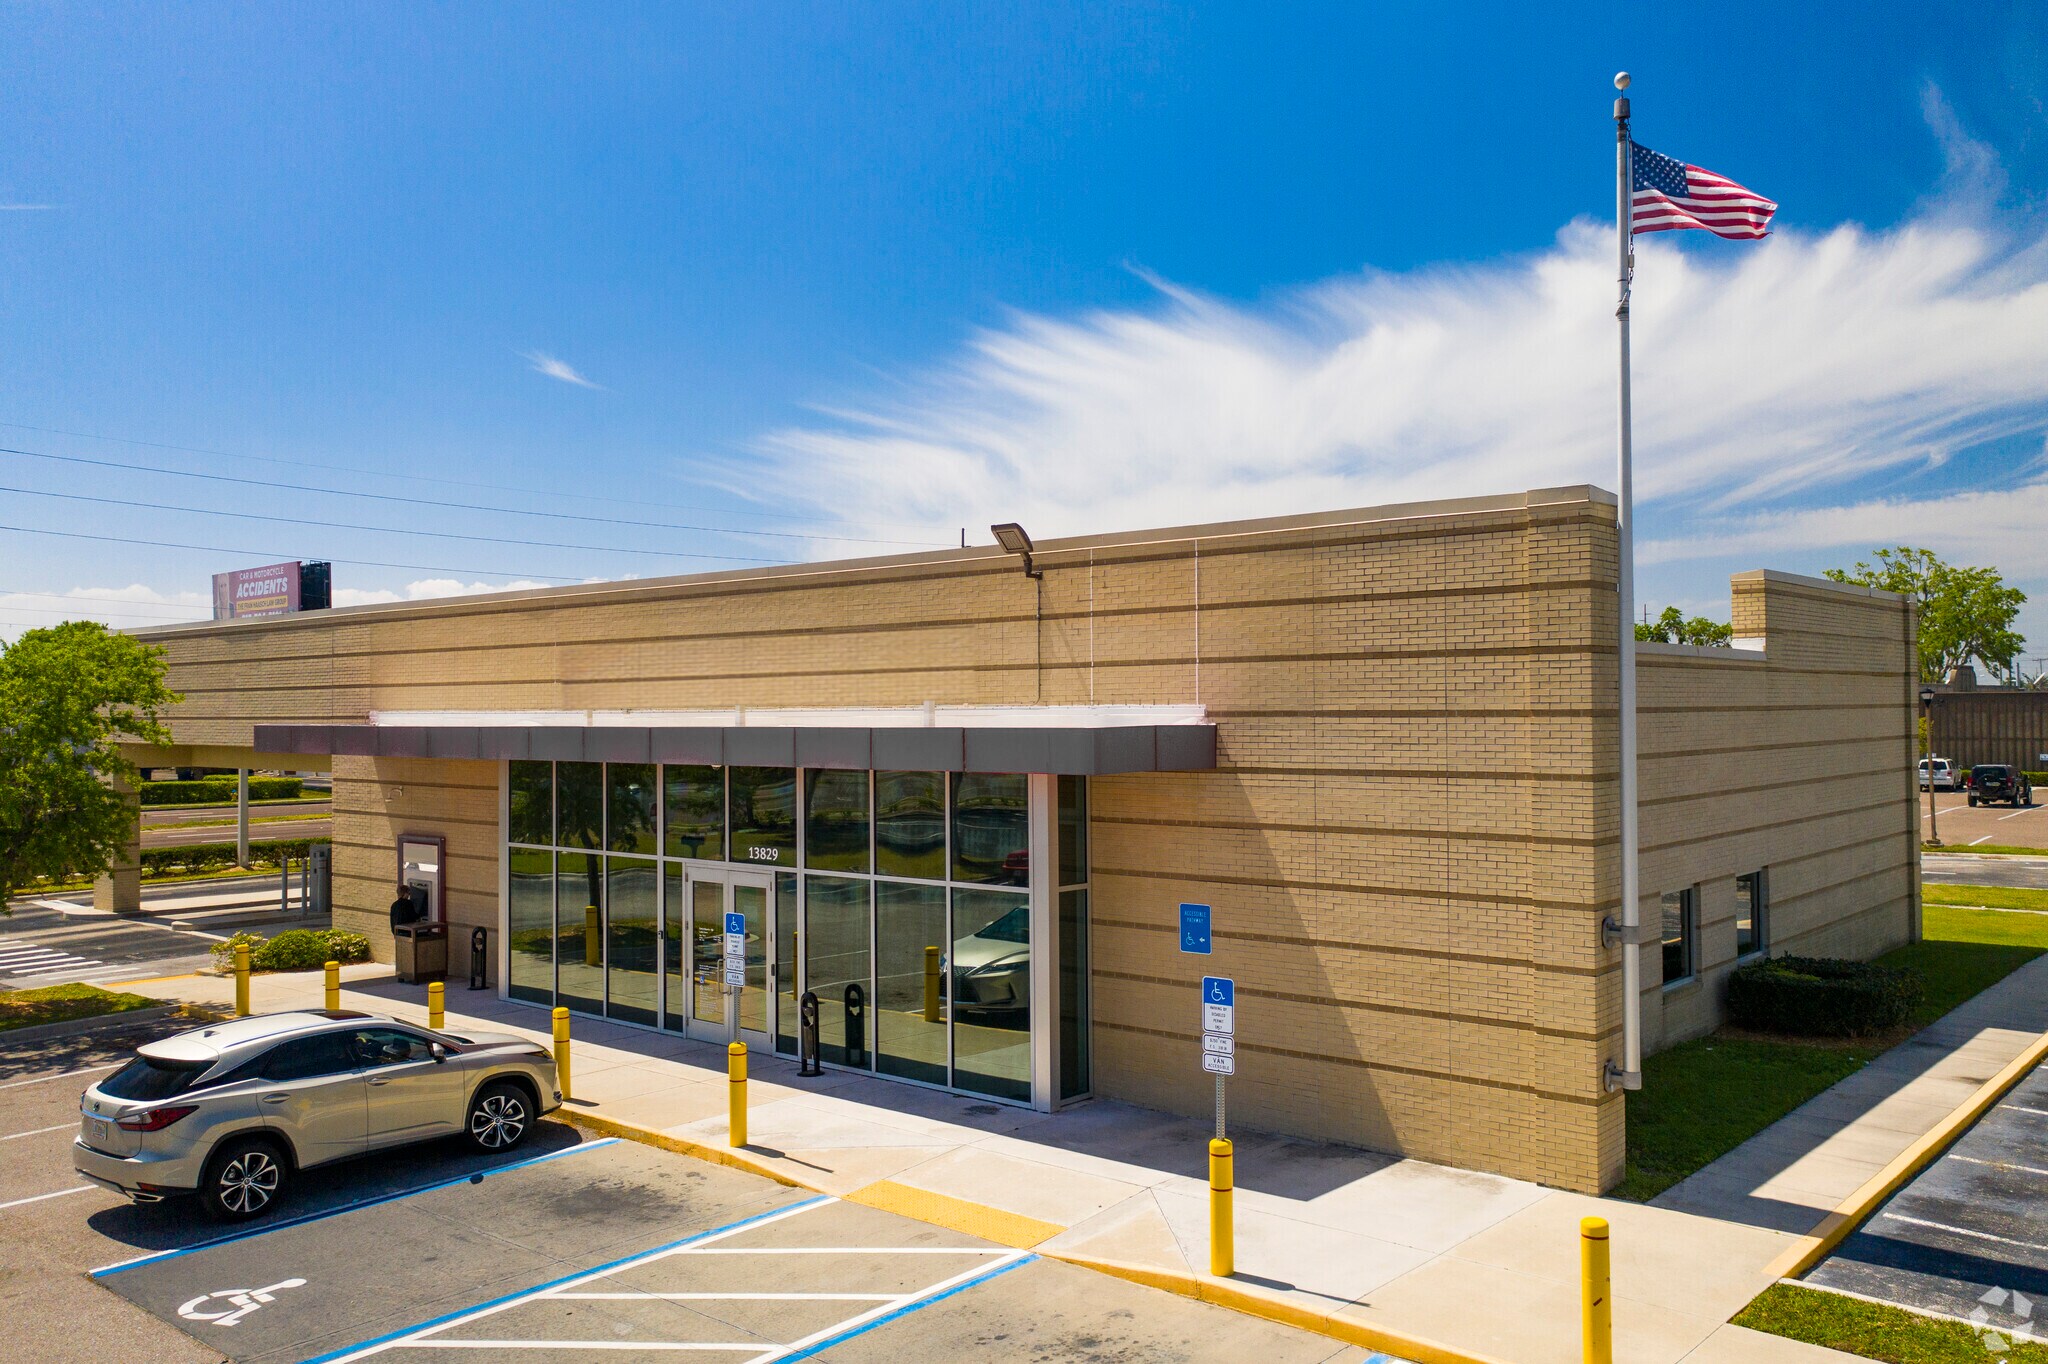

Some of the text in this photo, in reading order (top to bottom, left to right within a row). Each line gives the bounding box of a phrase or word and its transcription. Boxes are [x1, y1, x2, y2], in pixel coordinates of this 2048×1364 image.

[240, 572, 250, 580] CAR
[254, 567, 284, 578] MOTORCYCLE
[236, 577, 288, 598] ACCIDENTS
[749, 846, 778, 861] 13829
